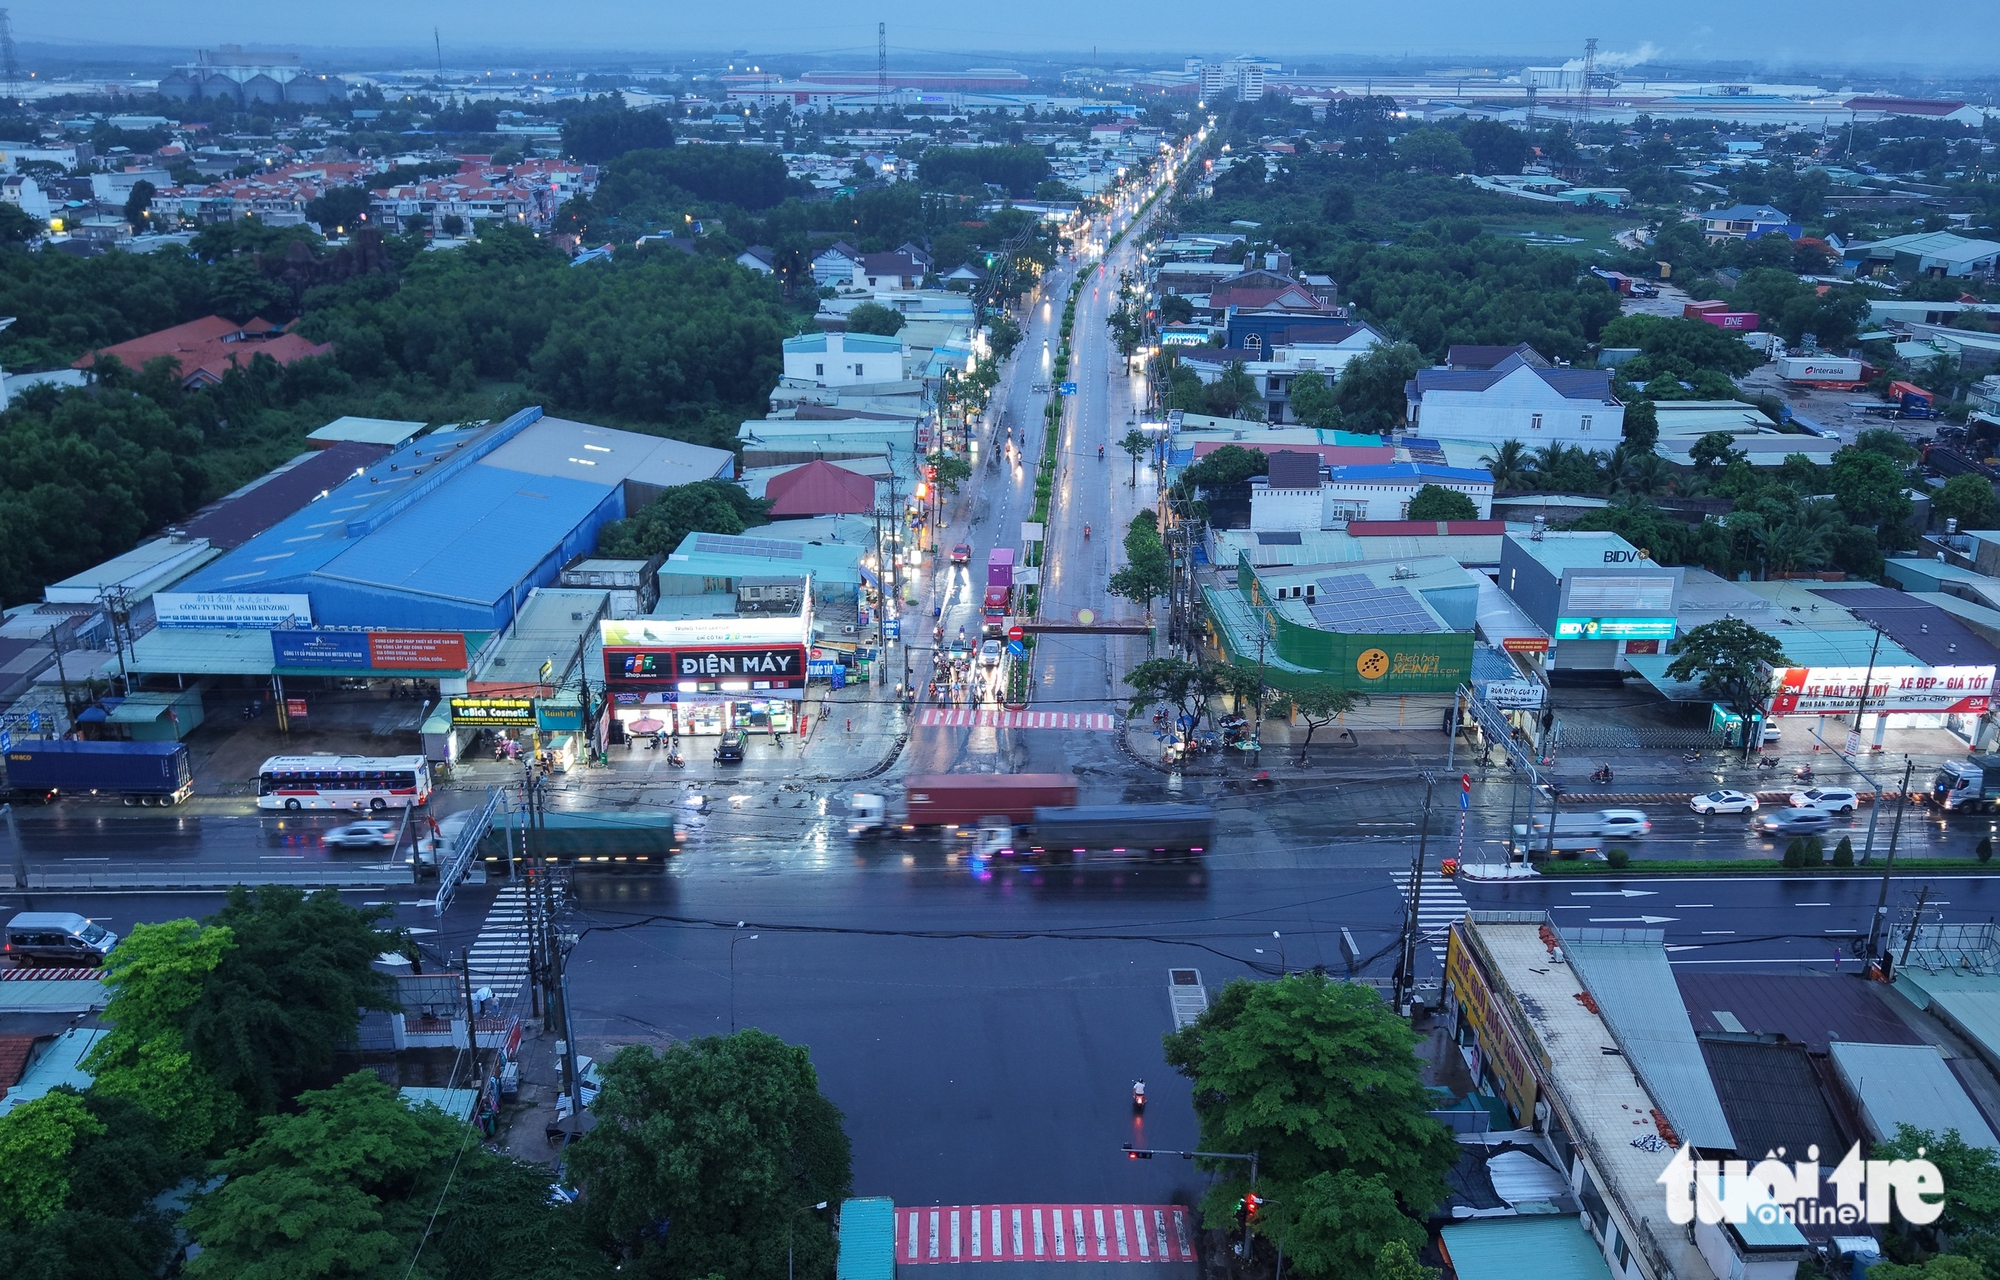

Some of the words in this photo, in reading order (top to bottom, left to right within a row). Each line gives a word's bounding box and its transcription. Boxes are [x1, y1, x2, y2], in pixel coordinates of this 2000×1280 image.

[1724, 316, 1743, 326] ONE
[1813, 367, 1844, 375] Interasia
[1603, 550, 1638, 563] BIDV
[180, 602, 200, 611] CÔNG
[1559, 623, 1589, 635] BIDV
[625, 654, 653, 672] FPT
[1394, 652, 1420, 663] Bách
[1421, 652, 1440, 663] hóa
[681, 653, 735, 677] ĐIỆN
[743, 651, 792, 673] MÁY
[1899, 677, 1914, 690] XE
[1916, 677, 1937, 691] ĐẸP
[1946, 674, 1965, 690] GIÁ
[1968, 672, 1989, 690] TỐT
[1806, 685, 1821, 698] XE
[1823, 682, 1846, 698] MÁY
[1872, 681, 1890, 698] MỸ
[1782, 698, 1788, 706] 2
[458, 707, 487, 716] LeBich
[490, 707, 529, 717] Cosmetic
[545, 709, 565, 717] Bánh
[1455, 944, 1472, 983] THẾ
[1504, 1040, 1525, 1087] KÍNH
